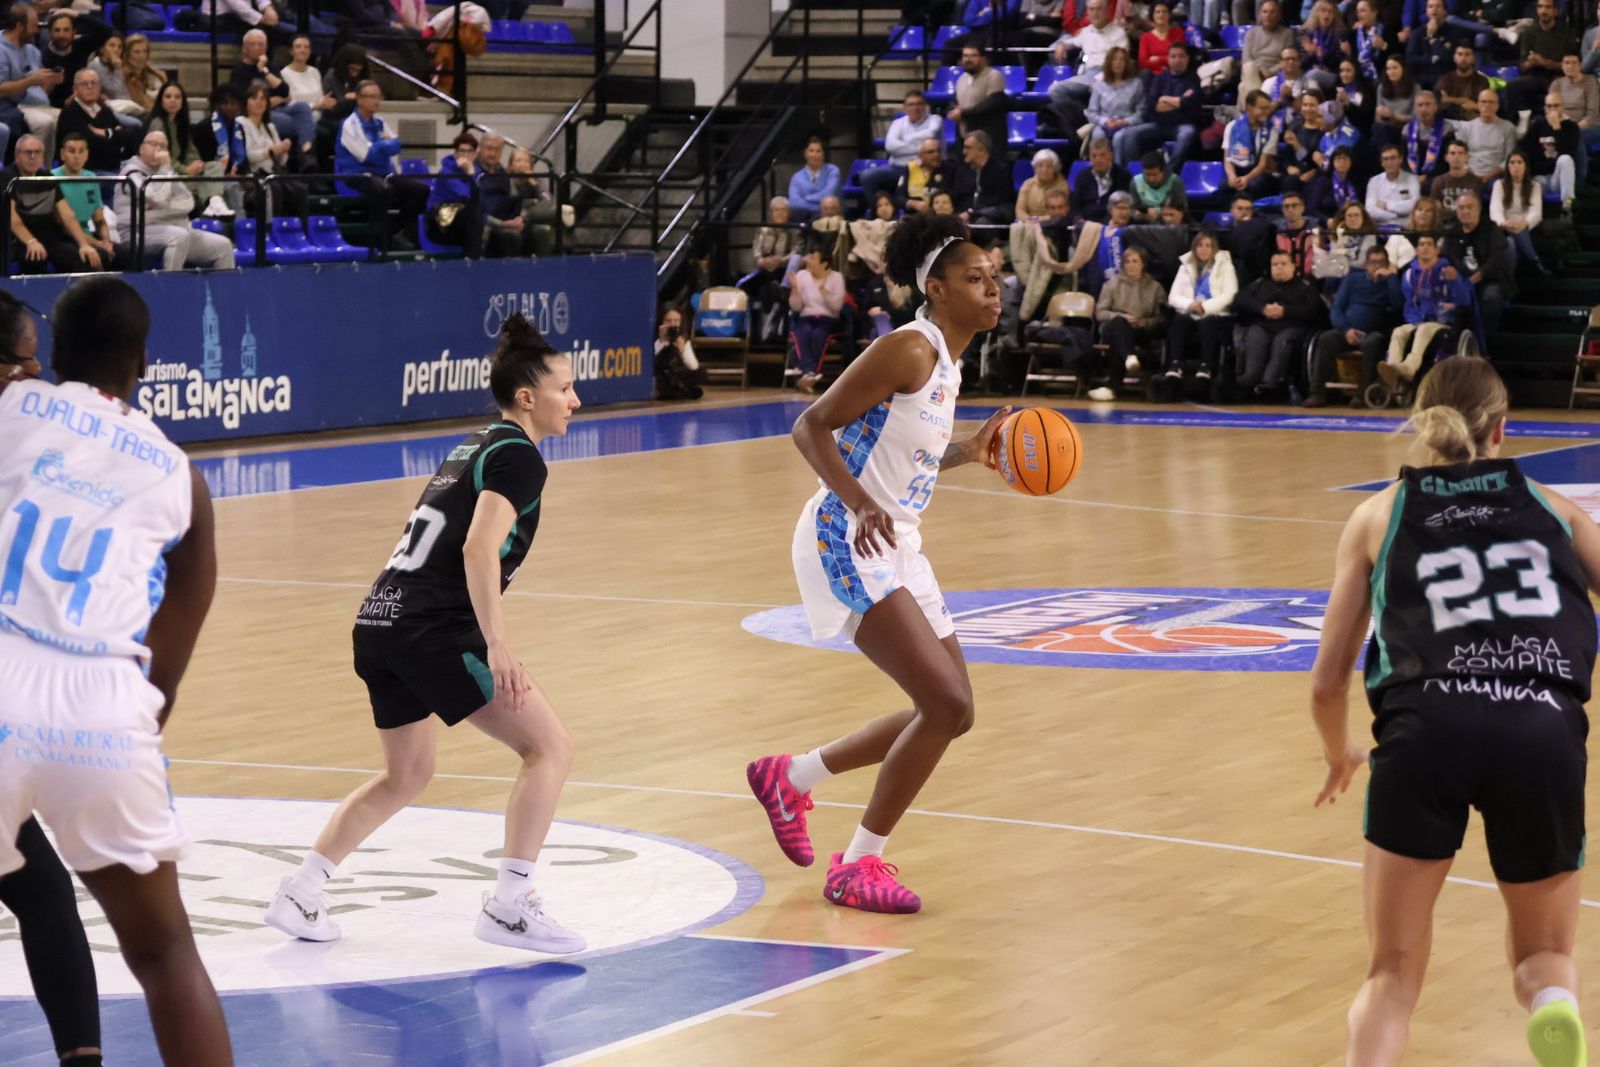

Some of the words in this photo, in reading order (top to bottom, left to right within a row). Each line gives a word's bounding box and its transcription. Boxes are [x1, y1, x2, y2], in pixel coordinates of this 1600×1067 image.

[138, 358, 188, 383] urismo
[898, 474, 937, 510] 55
[1, 498, 115, 627] 14
[1415, 539, 1562, 633] 23
[1447, 652, 1574, 680] COMPITE
